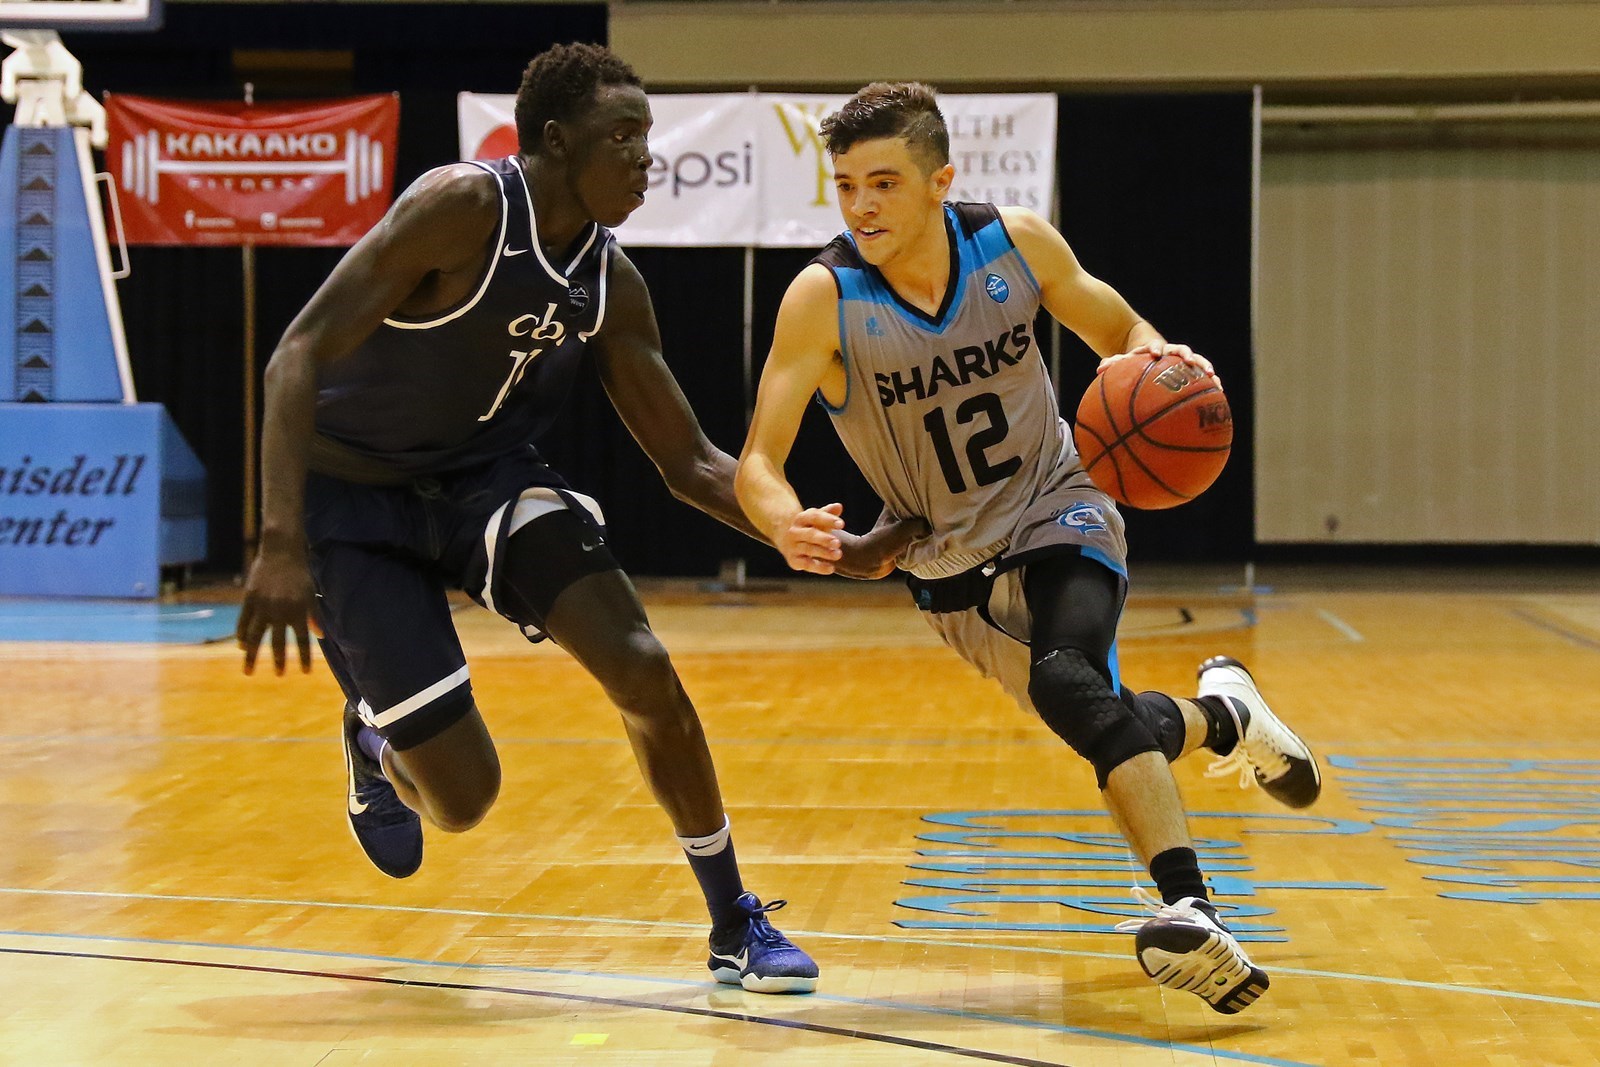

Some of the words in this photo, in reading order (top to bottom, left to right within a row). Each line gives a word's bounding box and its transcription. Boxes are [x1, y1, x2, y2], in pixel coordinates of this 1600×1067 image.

[166, 132, 337, 155] KAKAAKO
[508, 302, 567, 347] cb
[875, 323, 1031, 408] SHARKS
[923, 392, 1023, 494] 12
[0, 454, 147, 496] isdell
